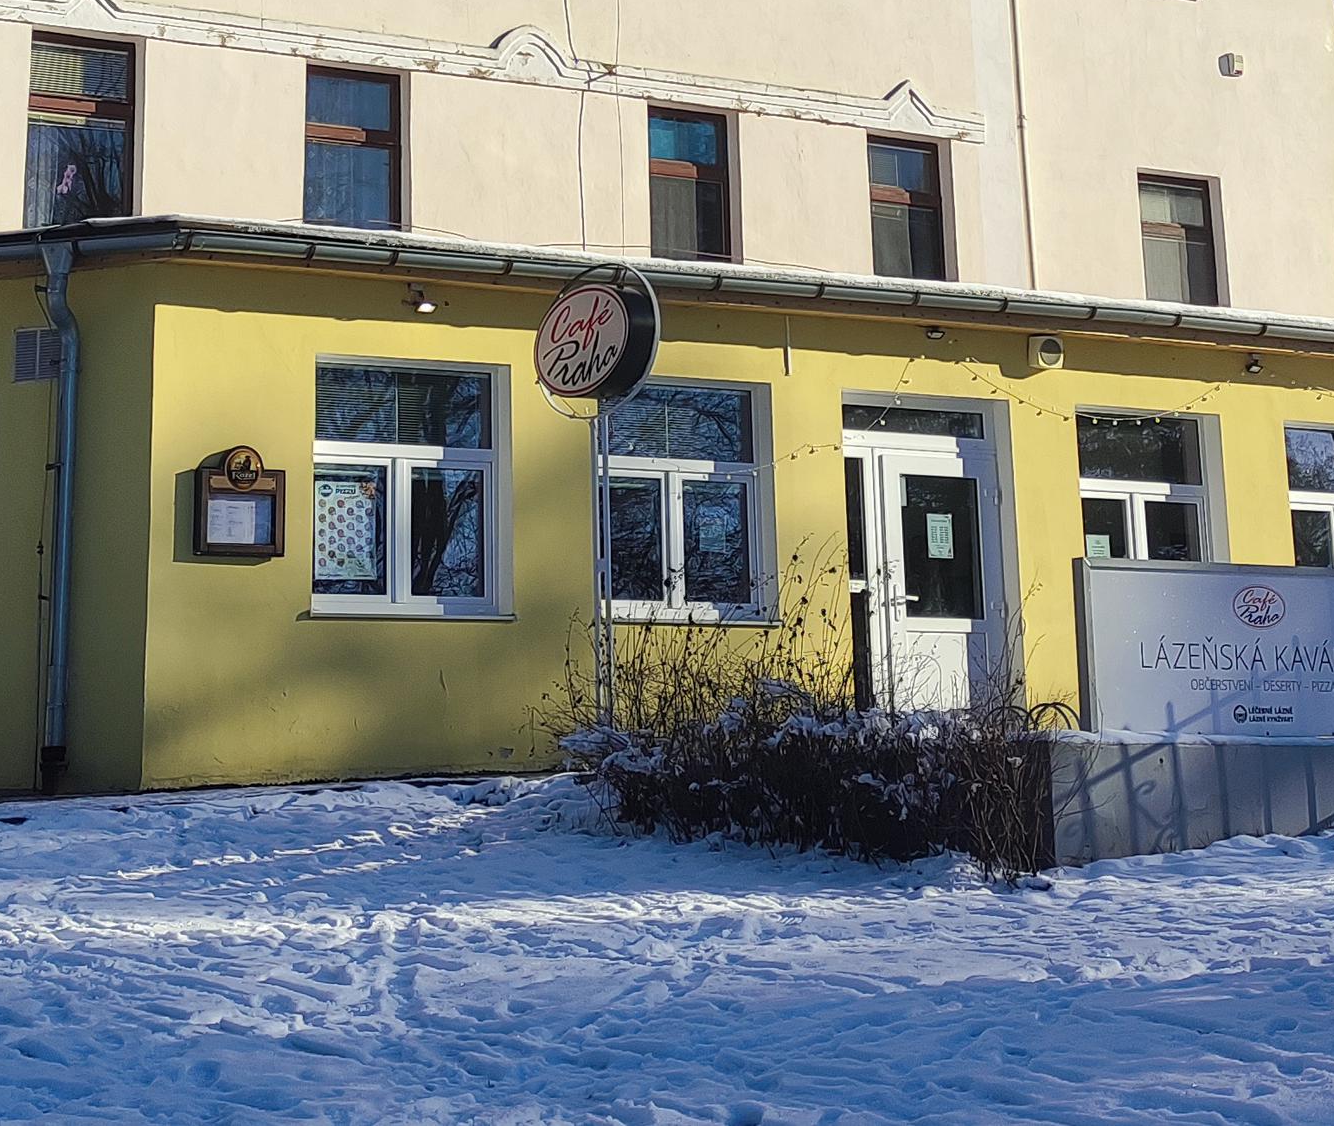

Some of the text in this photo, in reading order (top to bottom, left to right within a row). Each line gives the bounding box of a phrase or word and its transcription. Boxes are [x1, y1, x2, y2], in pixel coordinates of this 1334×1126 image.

[550, 295, 614, 351] Café
[543, 330, 618, 387] Praha
[1236, 605, 1280, 625] Praha
[1243, 590, 1278, 611] Café
[1140, 635, 1267, 672] LÁZEŇSKÁ
[1190, 677, 1254, 692] OBČERSTVENÍ
[1263, 681, 1302, 692] DESERTY
